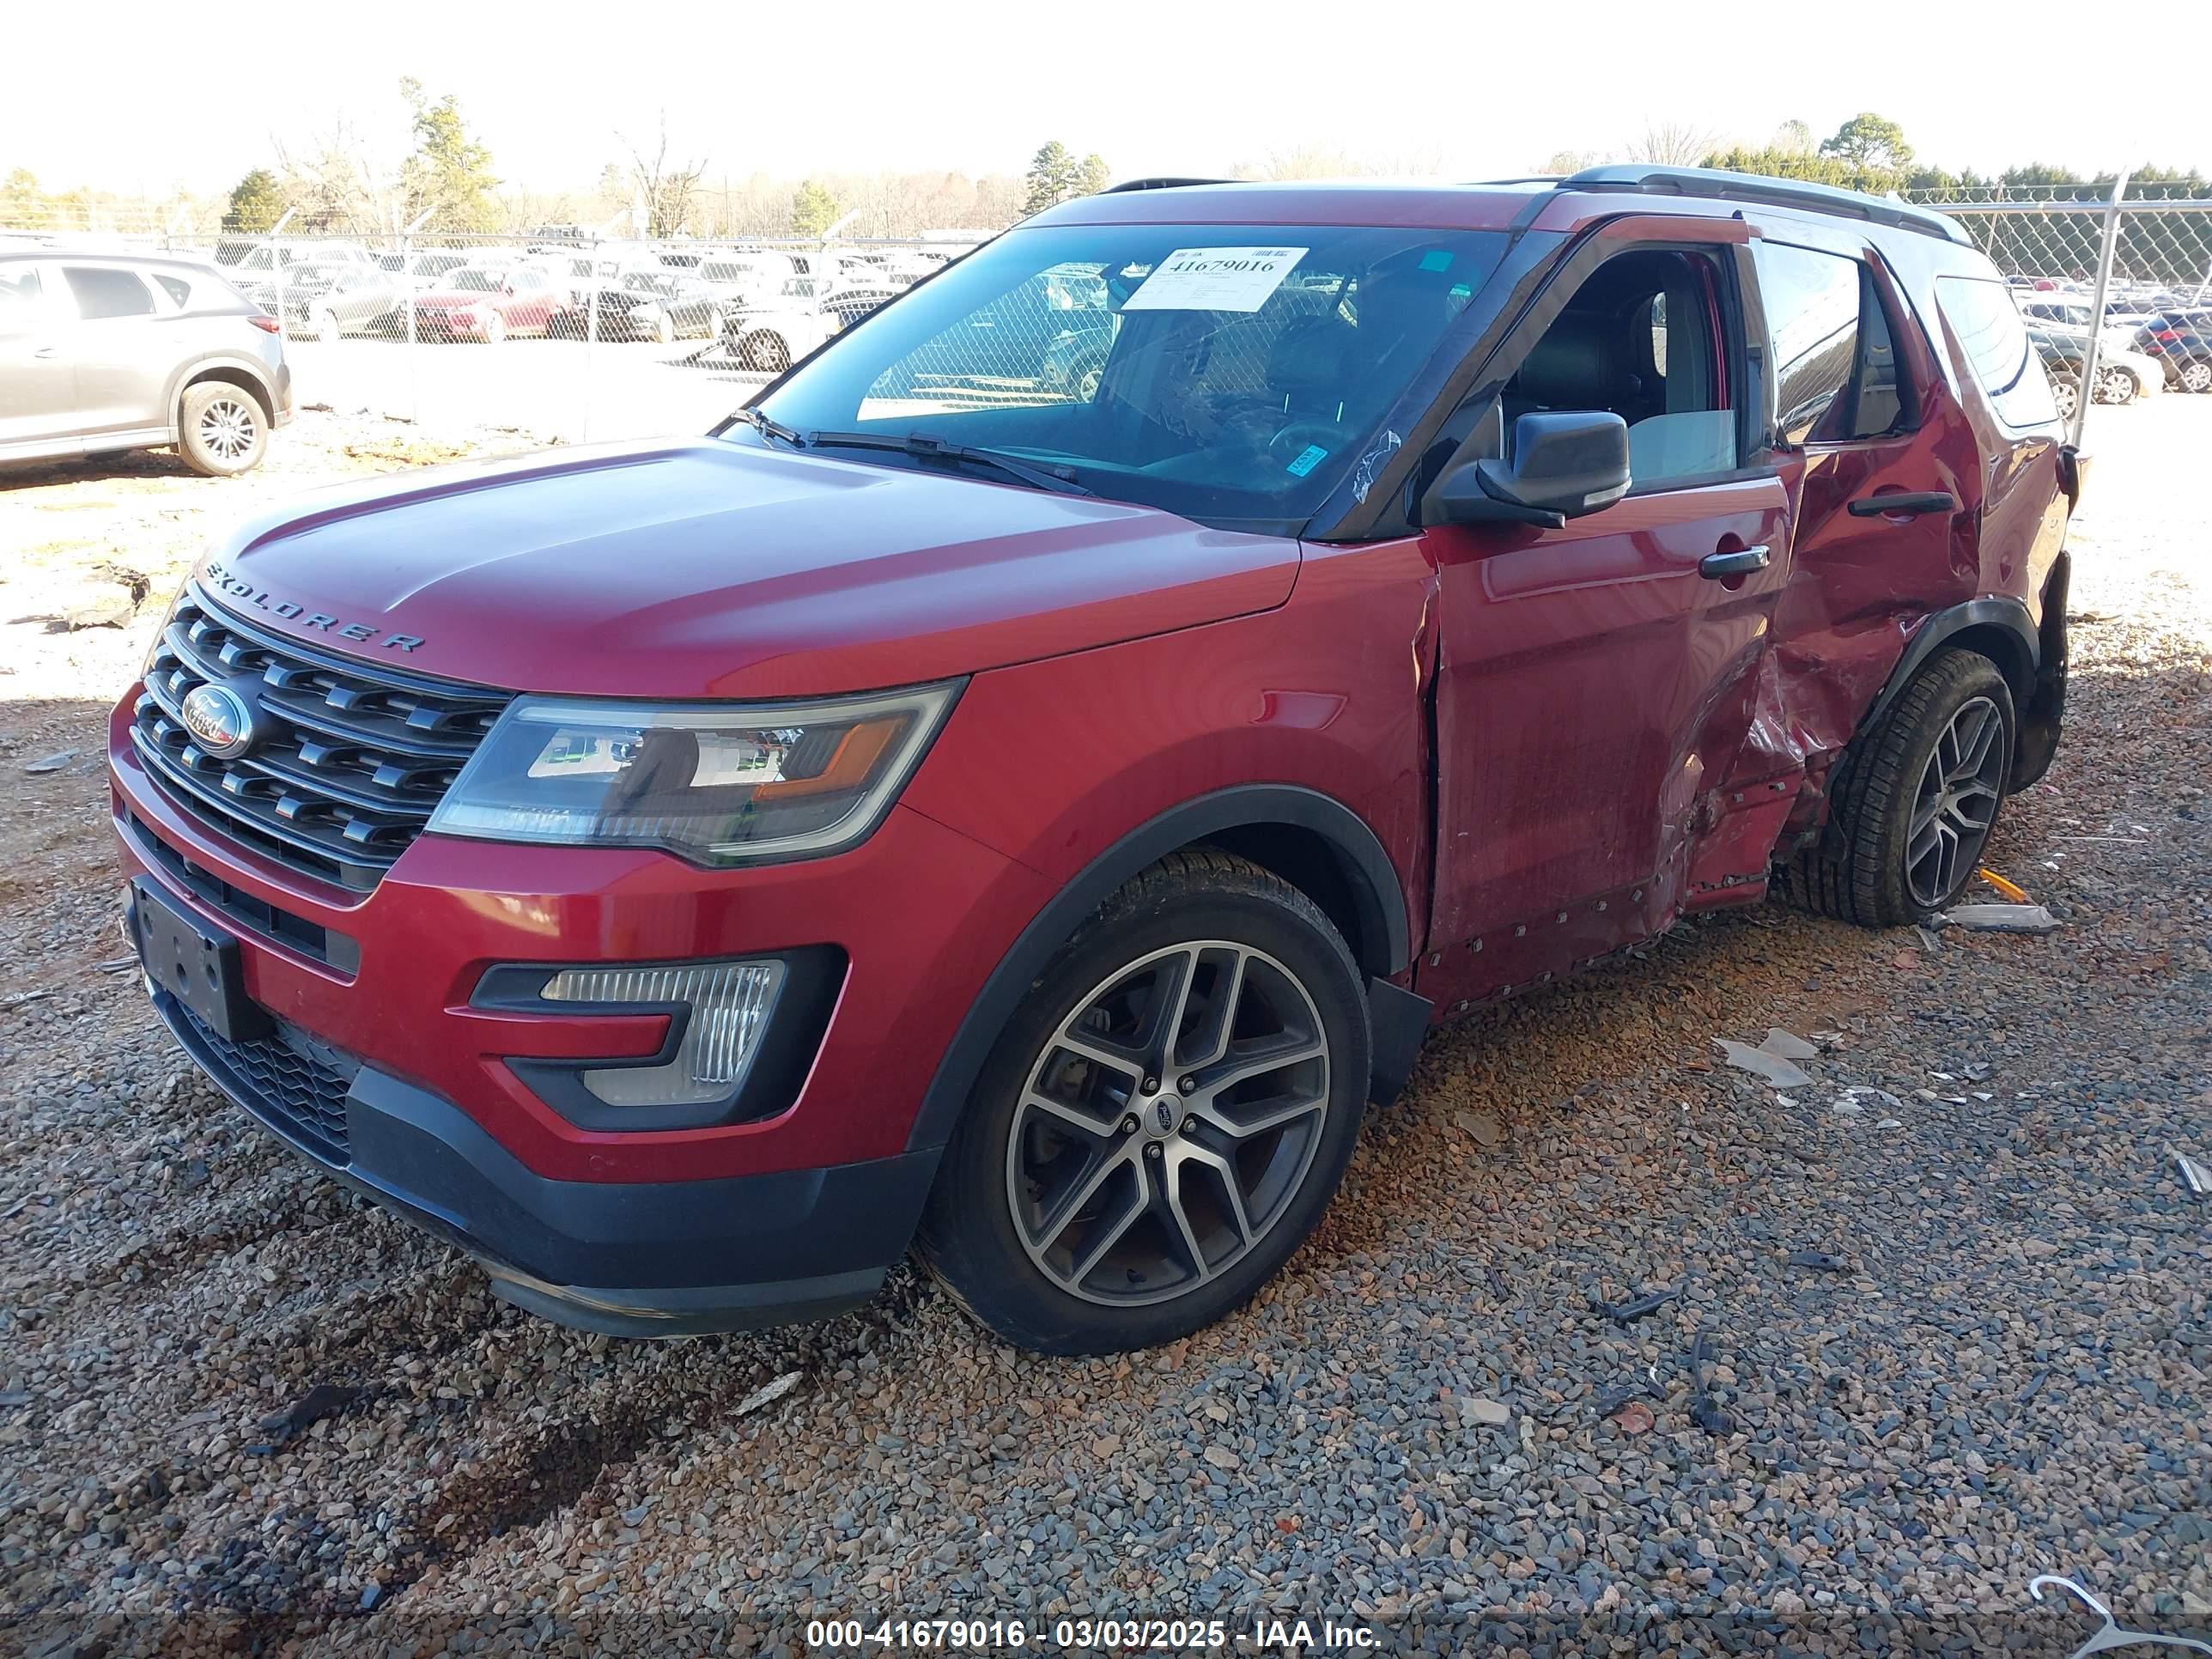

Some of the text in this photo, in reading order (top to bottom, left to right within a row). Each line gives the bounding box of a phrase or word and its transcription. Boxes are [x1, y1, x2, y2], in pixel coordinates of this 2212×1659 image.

[1170, 259, 1278, 272] 41679016
[206, 561, 426, 653] EXPLORER
[188, 693, 228, 739] Ford
[1159, 1105, 1171, 1127] Ford
